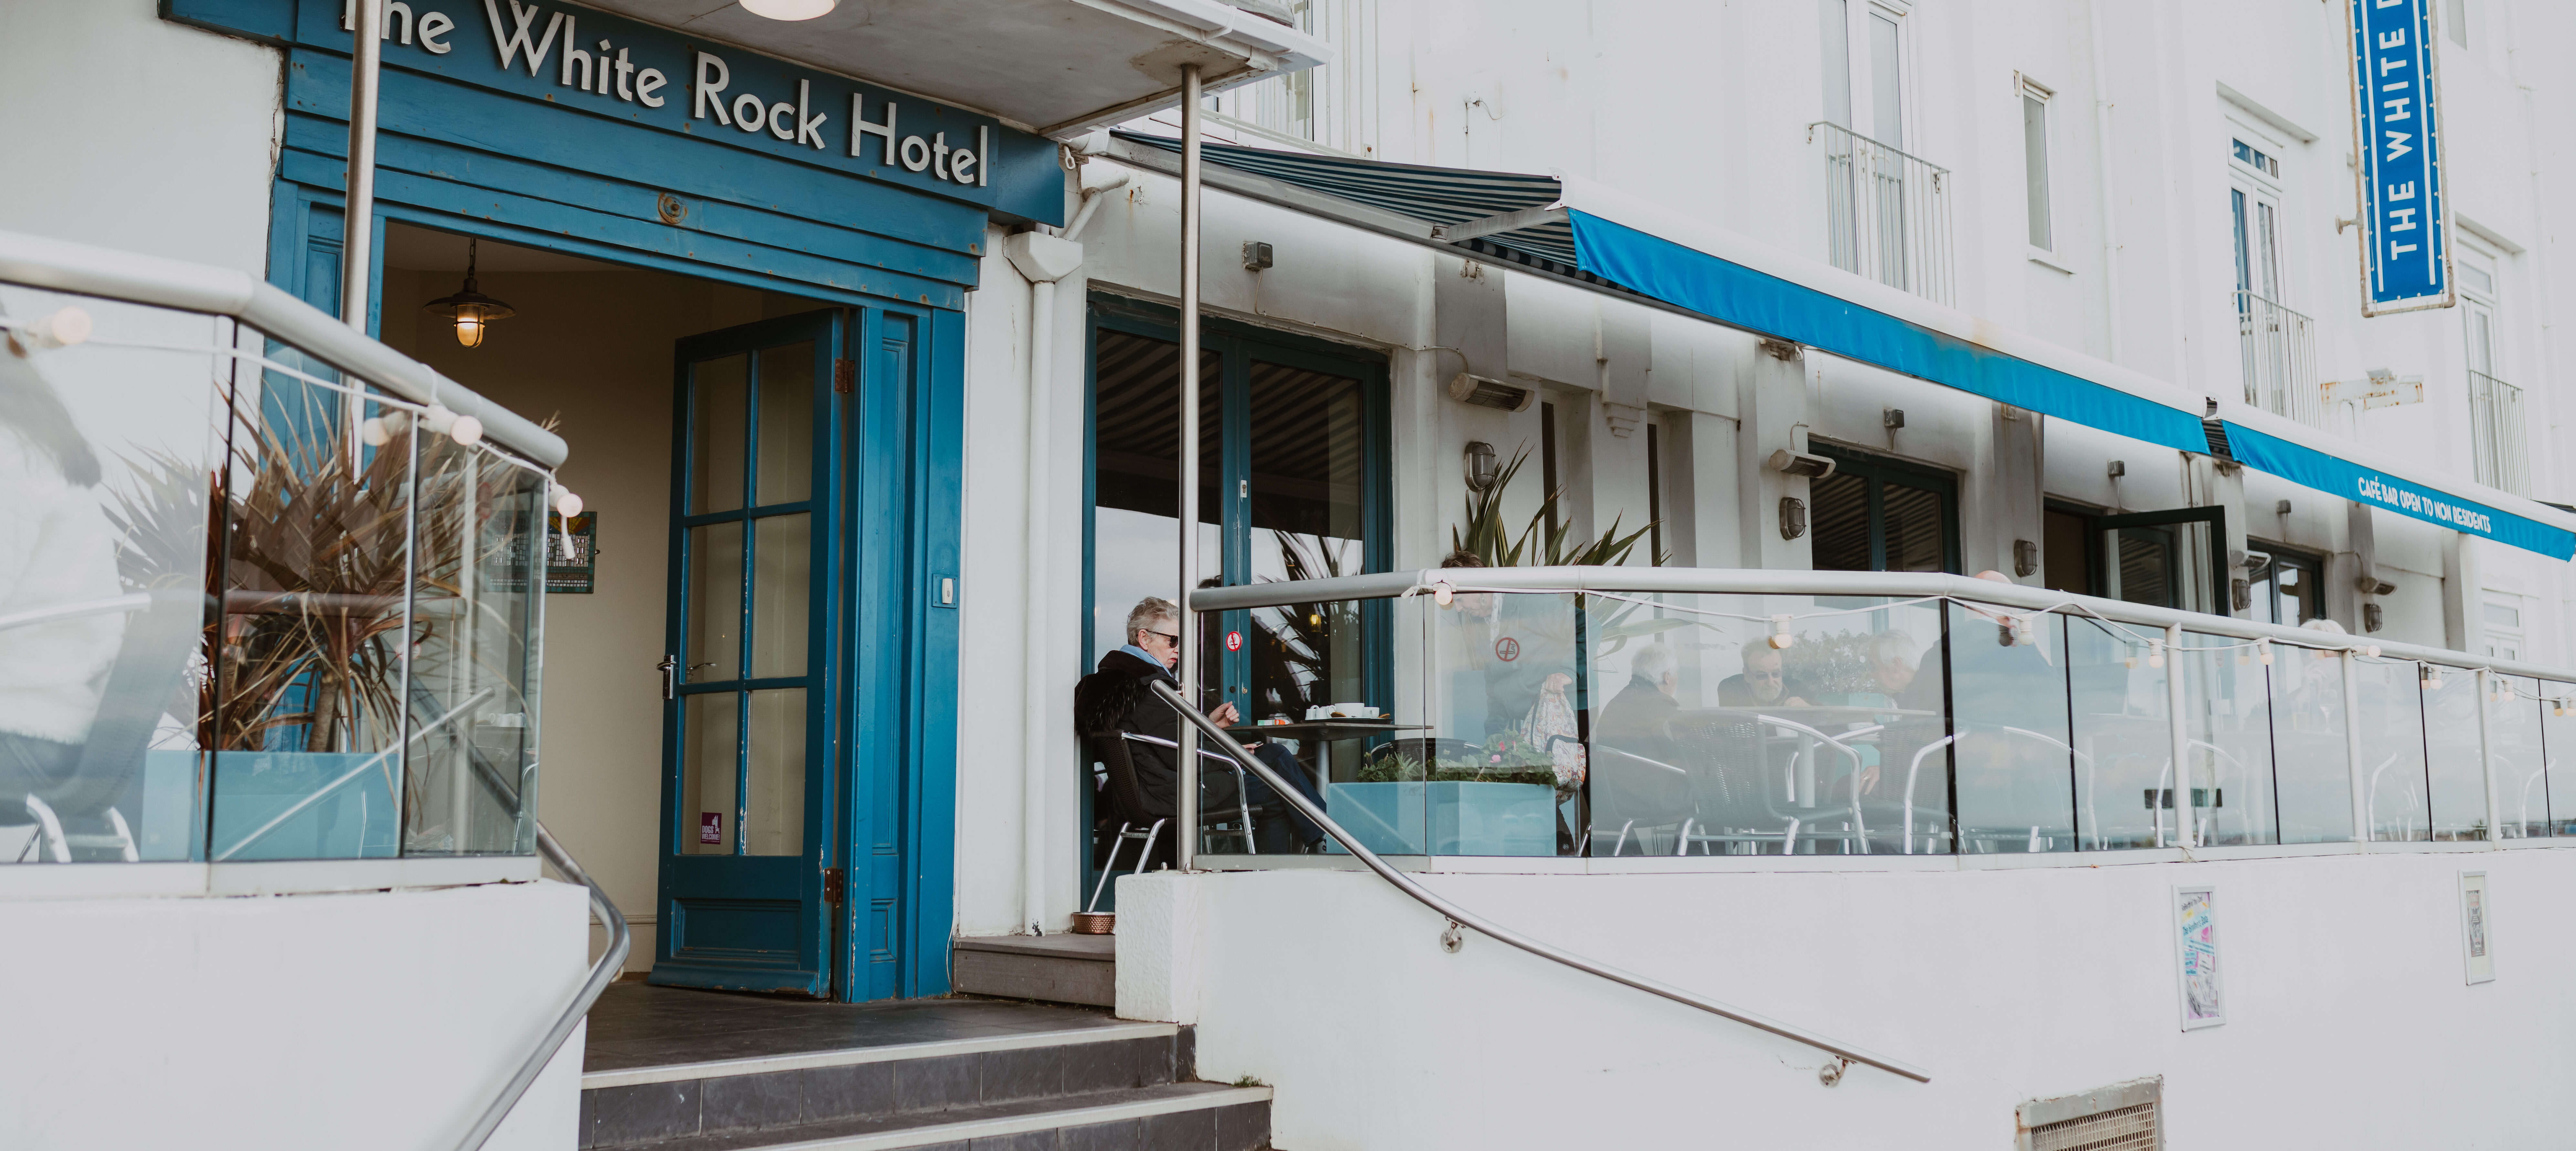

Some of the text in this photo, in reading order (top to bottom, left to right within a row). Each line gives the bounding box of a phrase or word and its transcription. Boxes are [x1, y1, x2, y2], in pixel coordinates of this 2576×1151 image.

[345, 0, 988, 186] he White Rock Hotel
[2379, 27, 2413, 162] WHITE
[2388, 180, 2417, 260] THE
[2358, 476, 2491, 533] CAFÉ BAR OPEN TO NON RESIDENTS
[702, 826, 714, 834] DOGS
